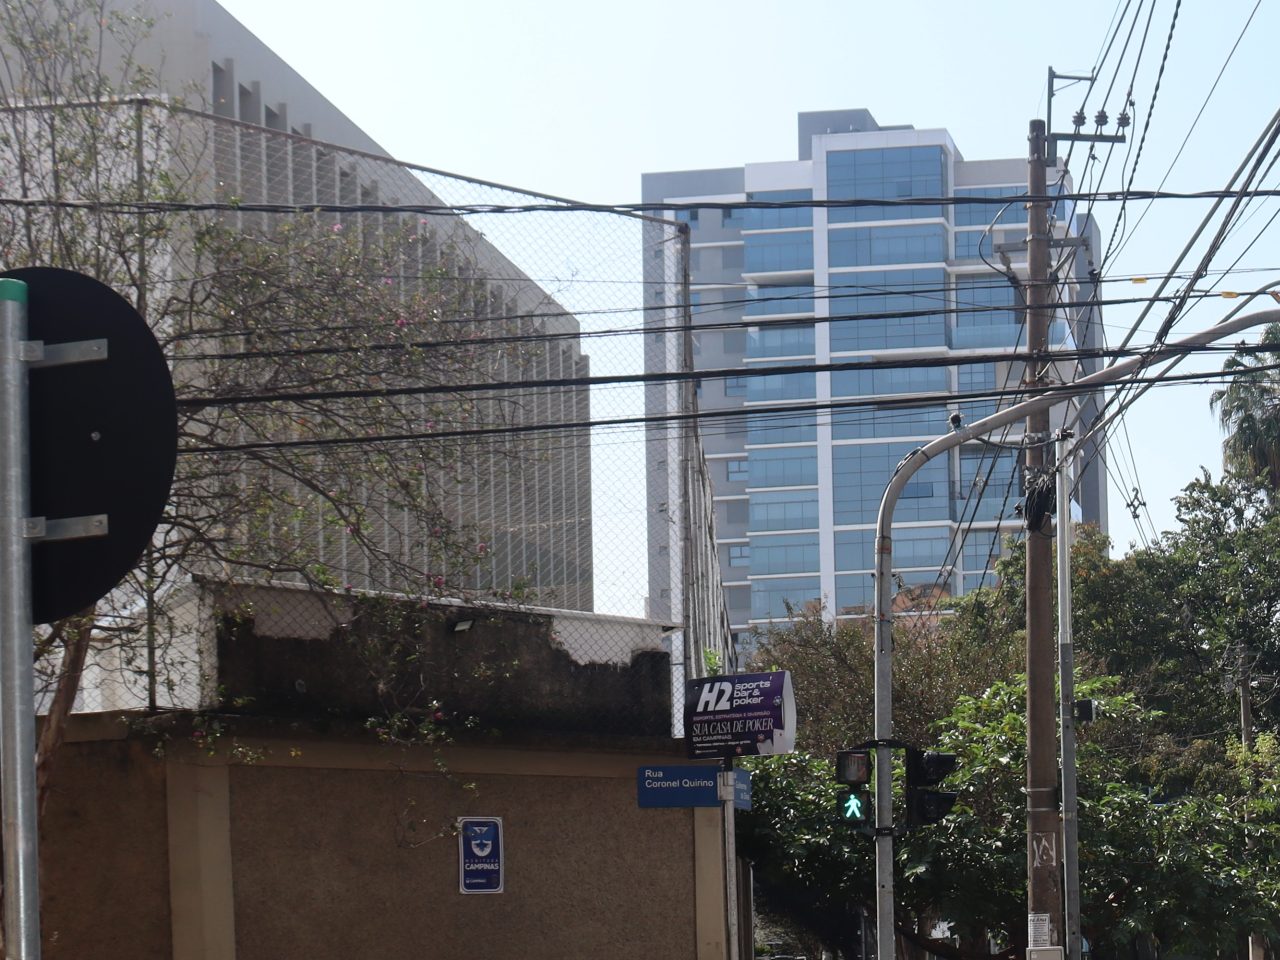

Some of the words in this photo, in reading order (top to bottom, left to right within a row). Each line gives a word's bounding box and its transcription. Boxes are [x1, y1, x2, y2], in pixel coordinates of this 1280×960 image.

[734, 681, 770, 691] sports
[696, 681, 732, 712] H2
[733, 689, 752, 698] bar
[752, 688, 760, 696] &
[732, 696, 764, 708] poker
[692, 722, 709, 735] SUA
[709, 721, 731, 734] CASA
[732, 720, 744, 733] DE
[745, 717, 774, 732] POKER
[645, 769, 663, 778] Rua
[645, 779, 680, 788] Coronel
[681, 778, 714, 788] Quirino
